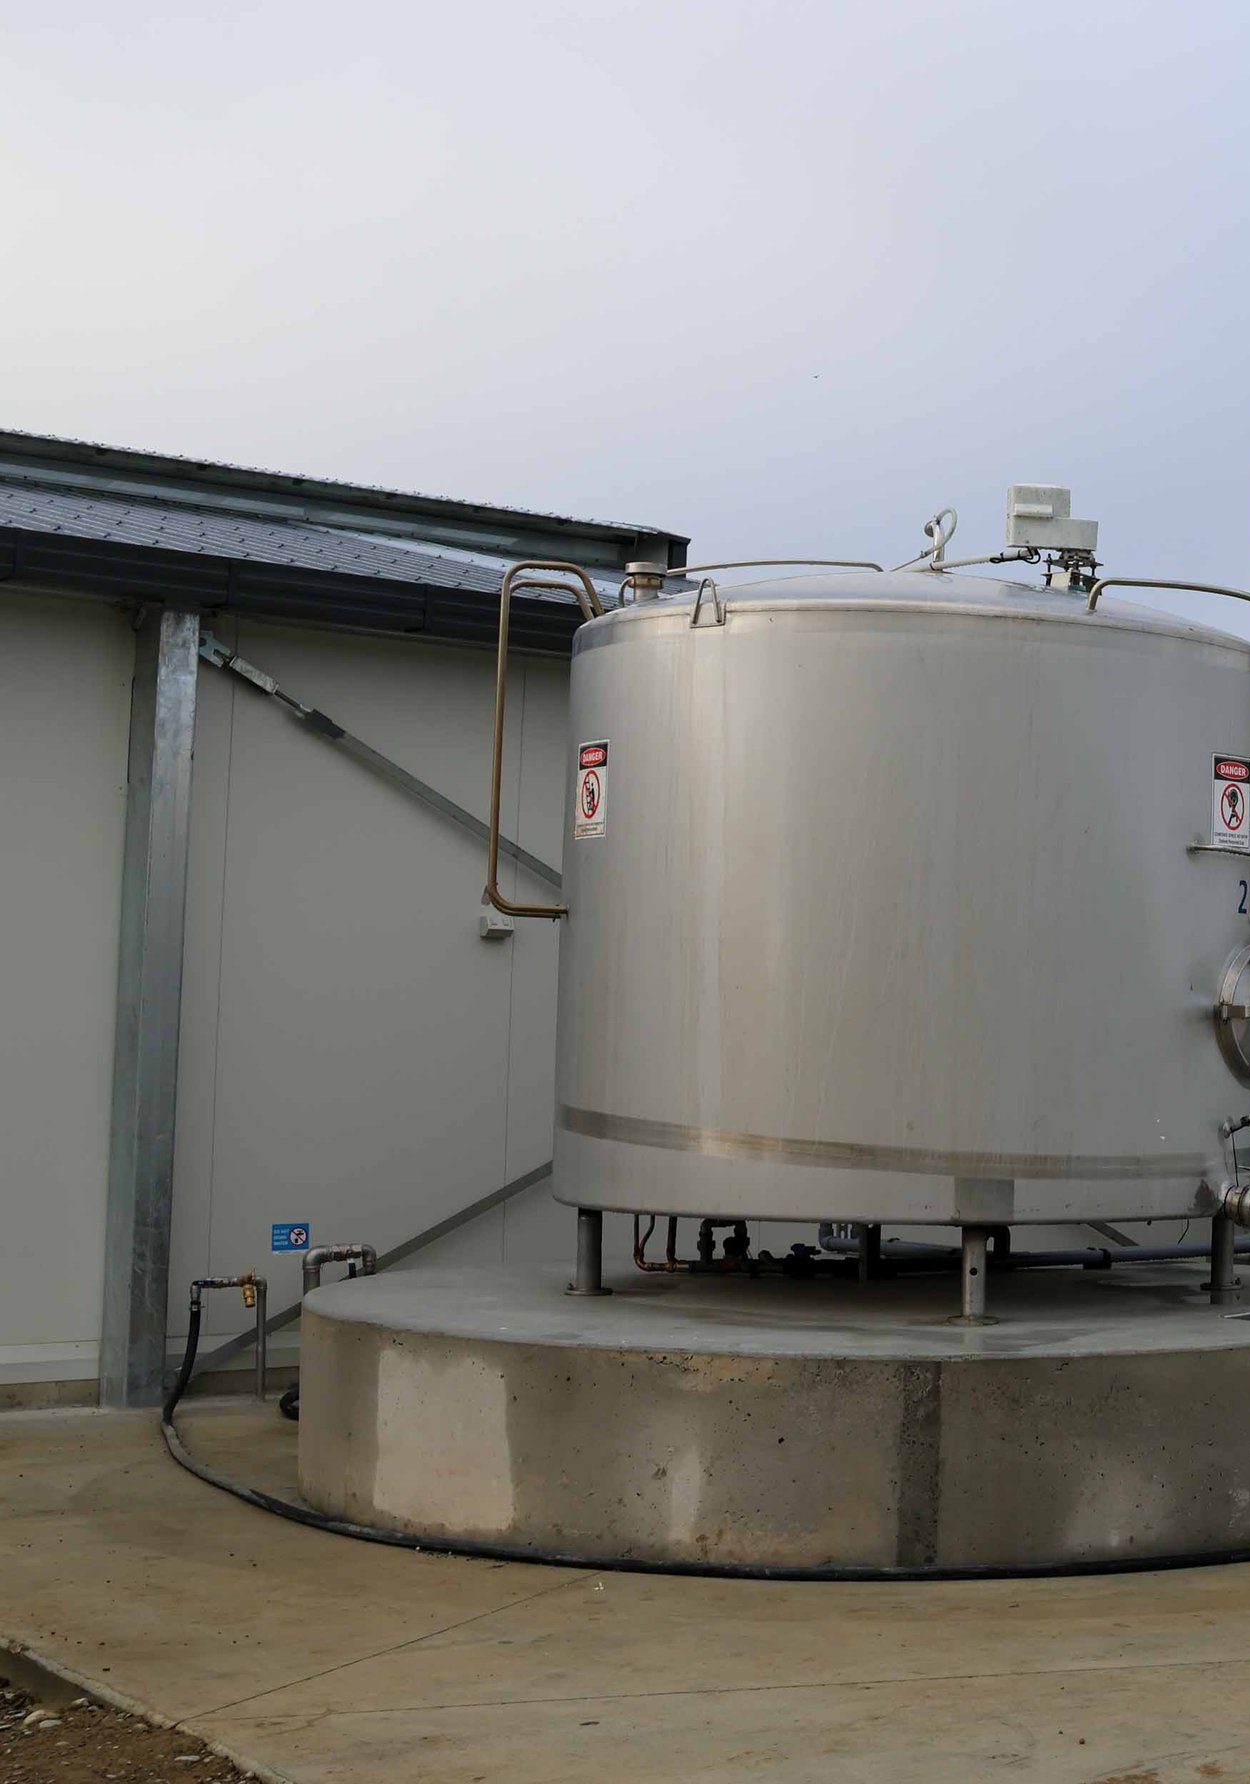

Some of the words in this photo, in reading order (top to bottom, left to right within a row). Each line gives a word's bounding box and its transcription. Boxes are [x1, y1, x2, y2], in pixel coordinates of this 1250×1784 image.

[583, 751, 603, 762] DANGER
[1221, 765, 1246, 776] DANGER
[1238, 880, 1248, 914] 2
